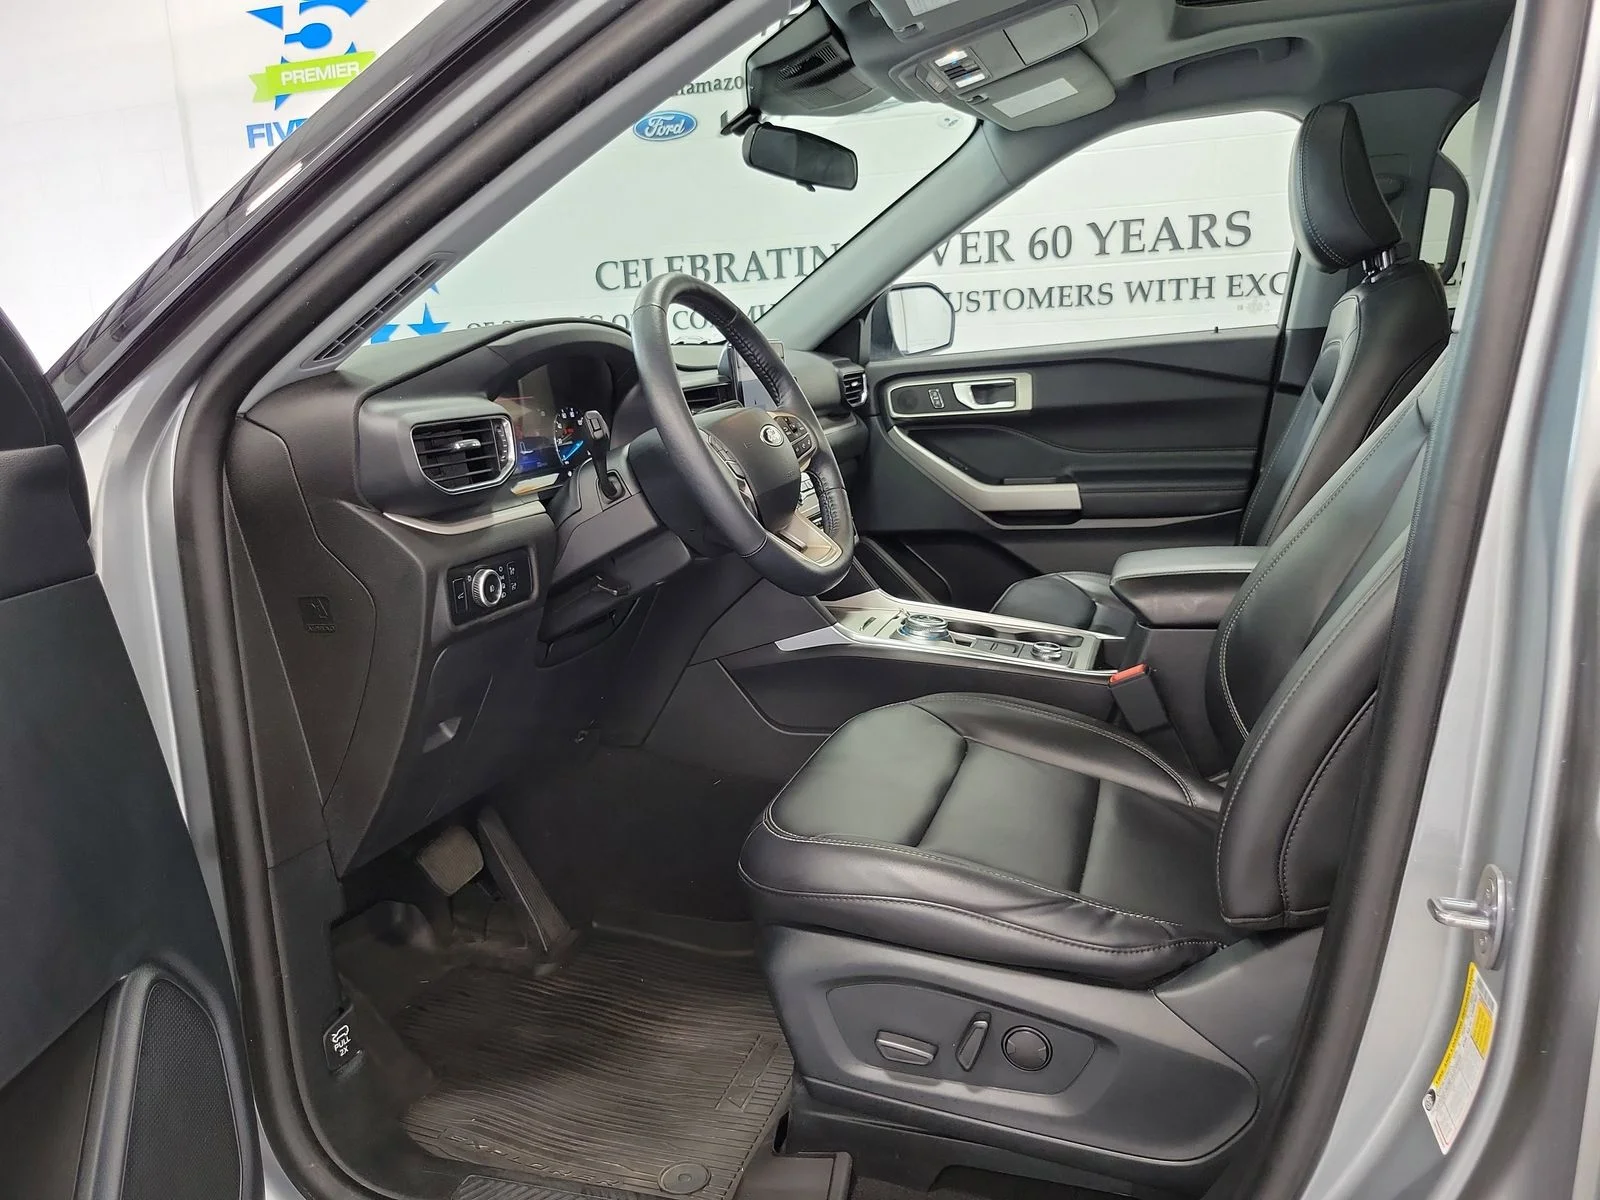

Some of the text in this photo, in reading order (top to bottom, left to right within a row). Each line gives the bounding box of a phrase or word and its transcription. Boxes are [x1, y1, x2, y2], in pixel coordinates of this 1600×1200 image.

[280, 61, 360, 86] PREMIER
[1028, 225, 1073, 260] 60
[1086, 210, 1252, 256] YEARS
[1123, 276, 1216, 304] WITH
[333, 1036, 352, 1052] PULL
[339, 1046, 349, 1057] 2X
